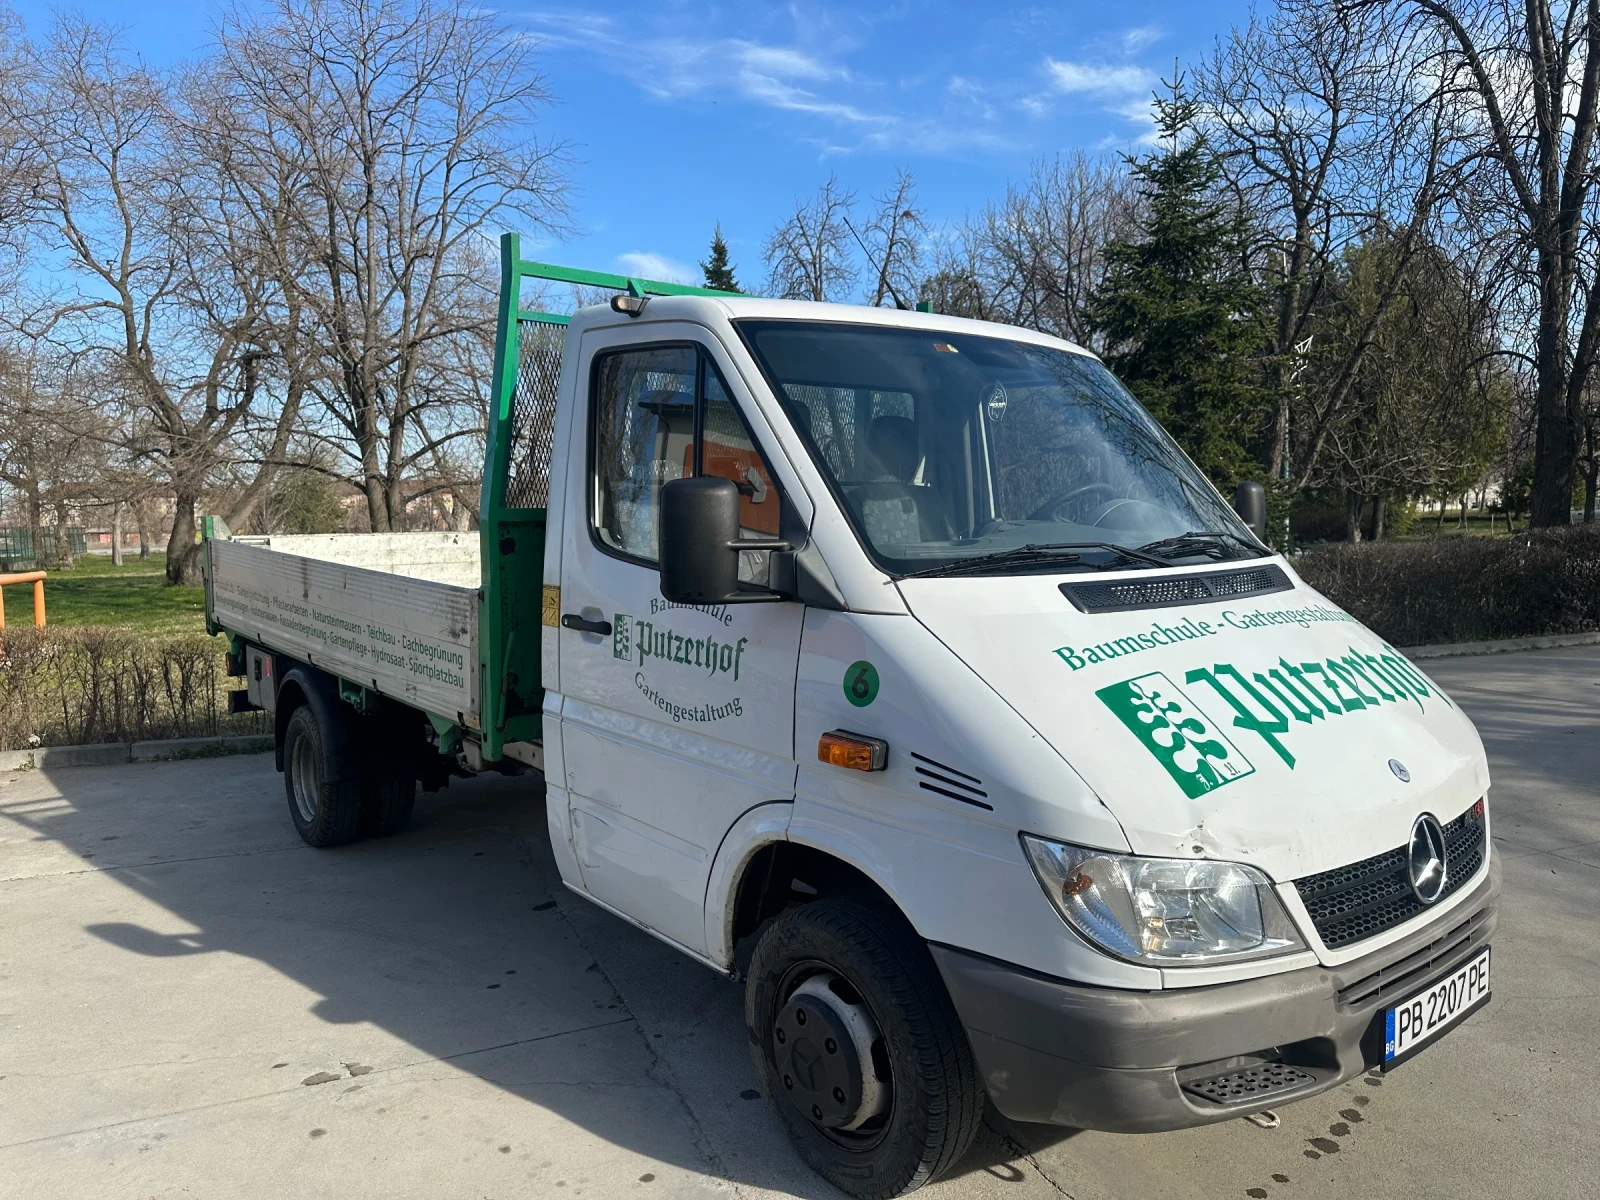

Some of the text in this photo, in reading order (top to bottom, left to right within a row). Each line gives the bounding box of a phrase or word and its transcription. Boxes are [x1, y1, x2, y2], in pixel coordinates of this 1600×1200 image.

[272, 596, 309, 618] Pflasterarbeiten
[312, 608, 362, 635] Natursteinmauern
[366, 624, 396, 646] Teichbau
[402, 634, 464, 670] Dachbegrünung
[279, 613, 327, 645] Fassadenbegrünung
[329, 631, 368, 657] Gartenpflege
[371, 644, 405, 669] Hydrosaat
[408, 656, 464, 689] Sportplatzbau
[635, 620, 748, 683] Putzerhof
[1053, 616, 1218, 671] Baumschule
[1221, 605, 1360, 631] Gartengestaltun
[634, 671, 743, 722] Gartengestaltung
[852, 668, 870, 699] 6
[1184, 641, 1454, 771] Putzerhof
[1398, 956, 1487, 1048] PB 2207 PE
[1385, 1040, 1395, 1055] BG
